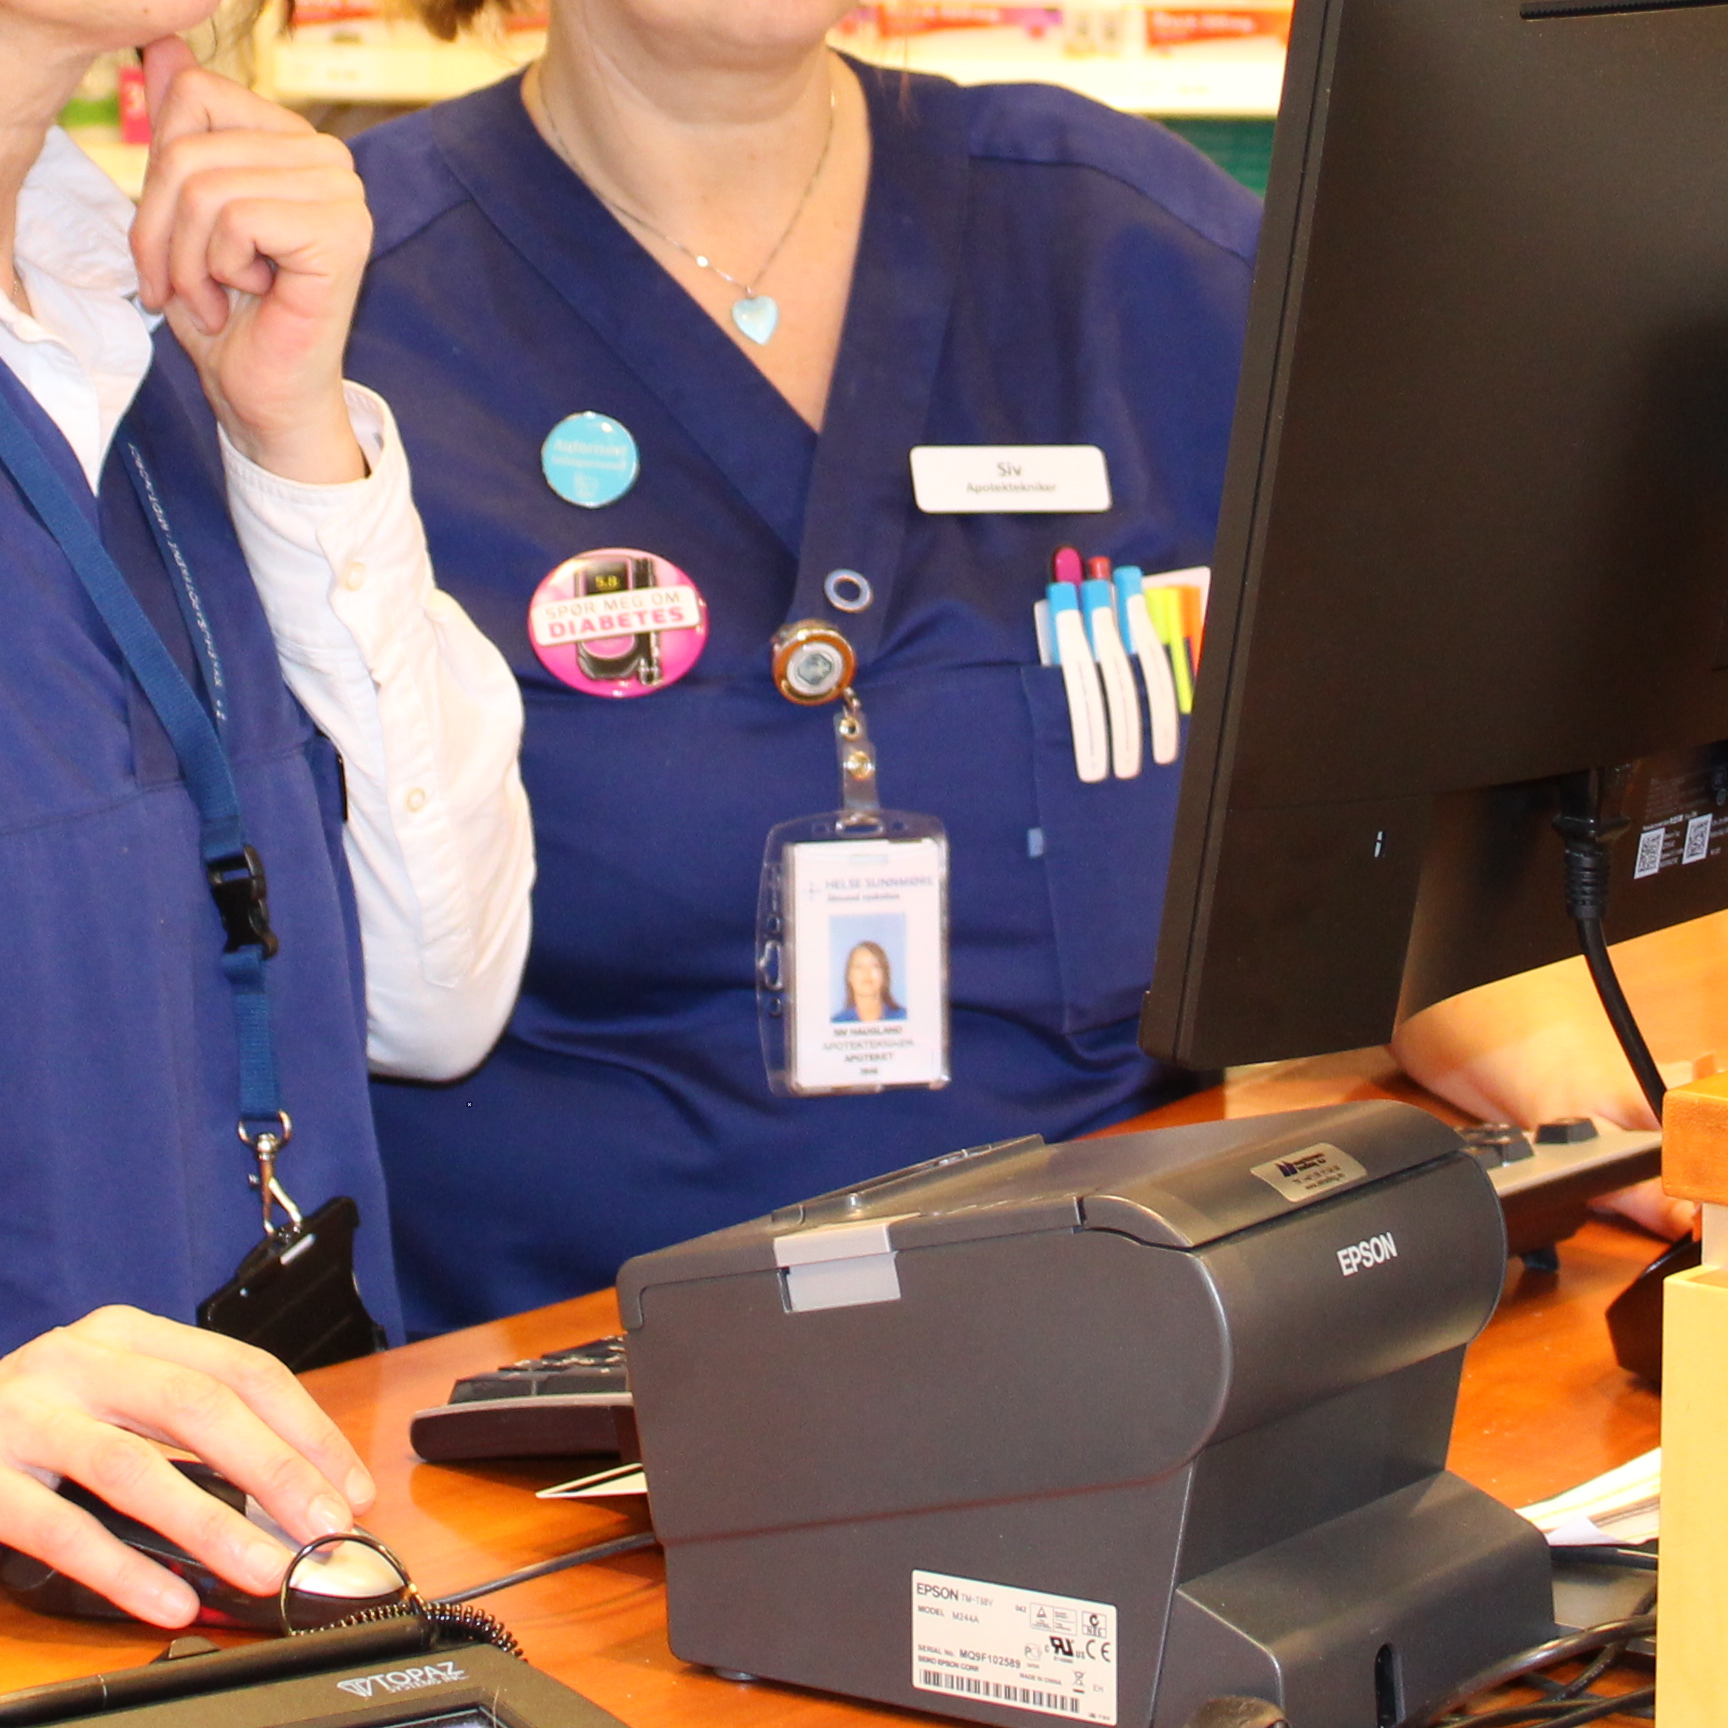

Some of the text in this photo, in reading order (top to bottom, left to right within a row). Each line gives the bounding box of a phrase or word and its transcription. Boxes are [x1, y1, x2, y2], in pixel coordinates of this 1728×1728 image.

[996, 461, 1022, 477] Siv
[545, 591, 681, 621] SPØR MEG OM
[548, 606, 685, 639] DIABETES
[1337, 1232, 1398, 1276] EPSON
[916, 1582, 959, 1602] EPSON
[918, 1605, 945, 1618] MODEL
[368, 1661, 465, 1692] TOPAZ
